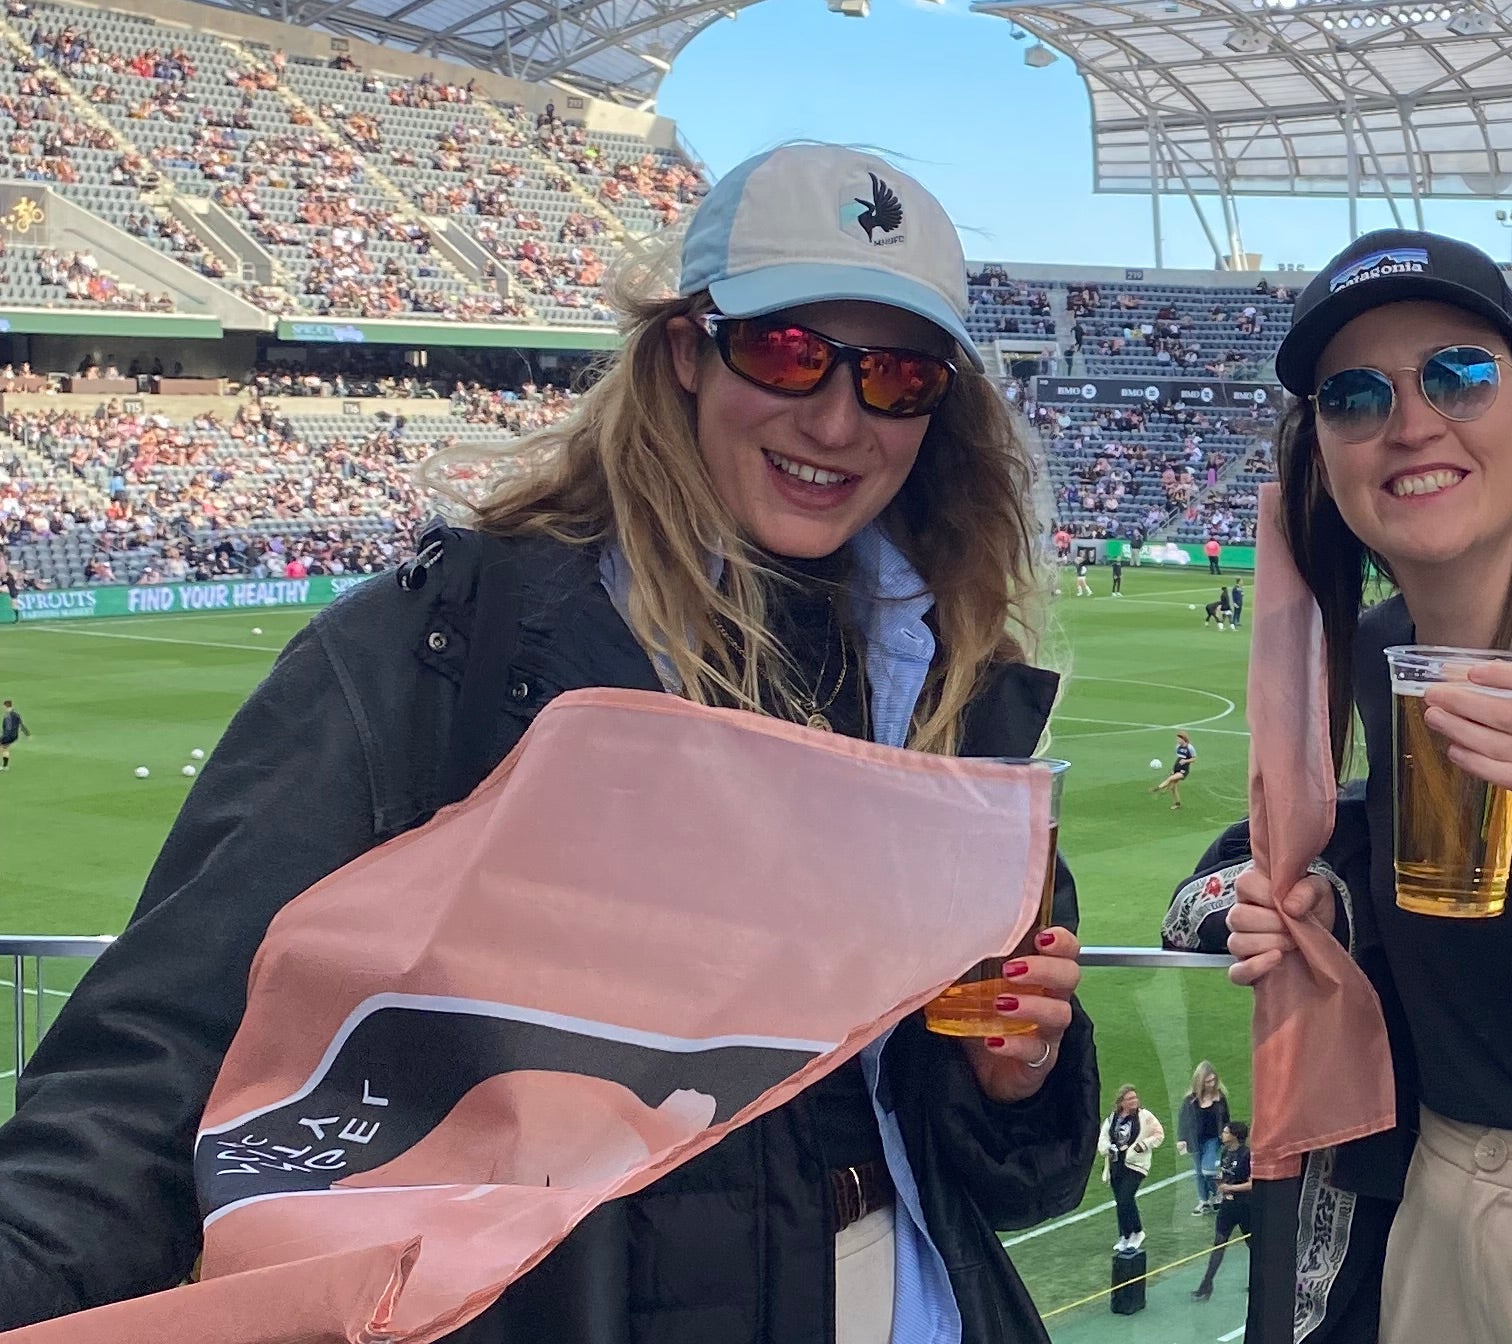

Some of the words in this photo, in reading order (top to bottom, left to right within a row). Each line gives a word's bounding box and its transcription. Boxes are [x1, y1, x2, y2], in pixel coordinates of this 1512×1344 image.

[1057, 386, 1081, 395] BMO
[17, 591, 96, 610] SPROUTS
[128, 587, 174, 612] FIND
[179, 585, 228, 609] YOUR
[233, 581, 309, 606] HEALTHY
